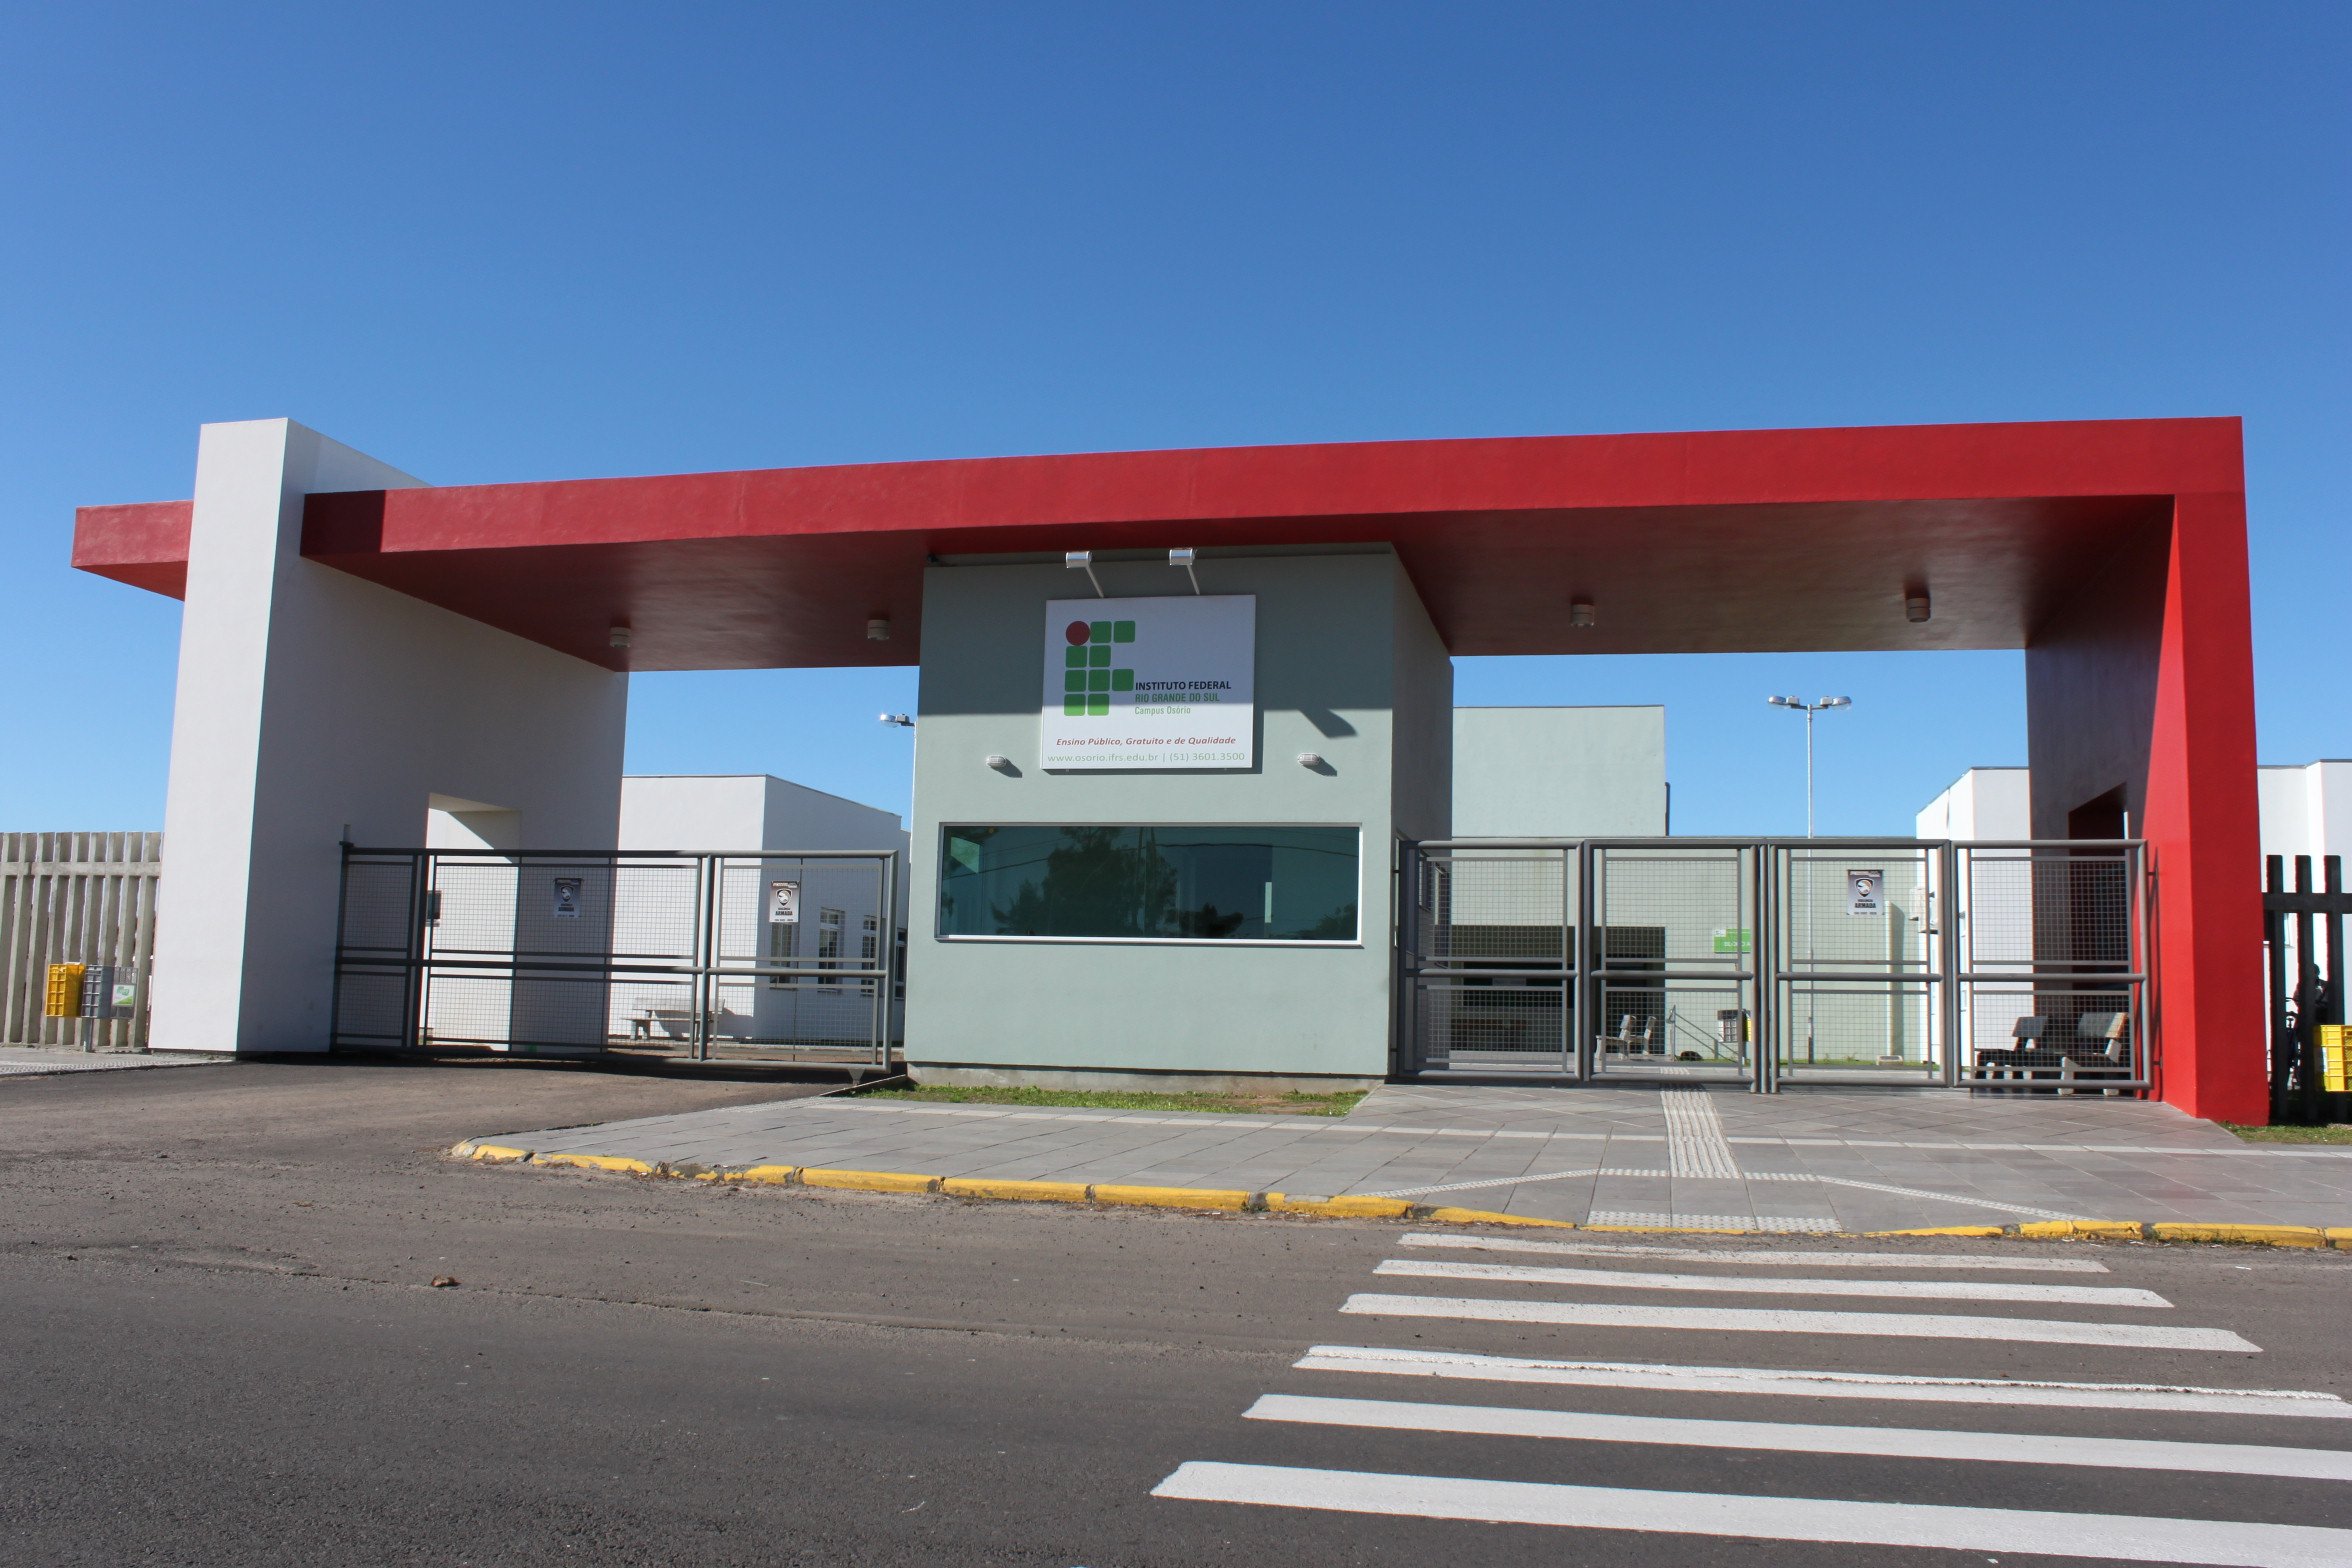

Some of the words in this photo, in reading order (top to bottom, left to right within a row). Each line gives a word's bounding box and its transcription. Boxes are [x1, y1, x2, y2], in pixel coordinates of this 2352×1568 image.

[1135, 681, 1186, 691] INSTITUTO
[1188, 680, 1232, 690] FEDERAL
[1135, 693, 1150, 703] RIO
[1152, 692, 1186, 703] GRANDE
[1189, 692, 1201, 702] DO
[1203, 692, 1220, 702] SUL
[1134, 706, 1165, 716] Campus
[1166, 705, 1191, 715] Osório
[1056, 738, 1086, 746] Ensino
[1088, 737, 1123, 747] Público,
[1125, 737, 1164, 746] Gratuito
[1174, 736, 1186, 745] de
[1188, 736, 1236, 746] Qualidade
[1047, 753, 1159, 763] www.osorio.ifrs.edu.br
[1169, 752, 1190, 763] (51)
[1192, 752, 1246, 762] 3601.3500
